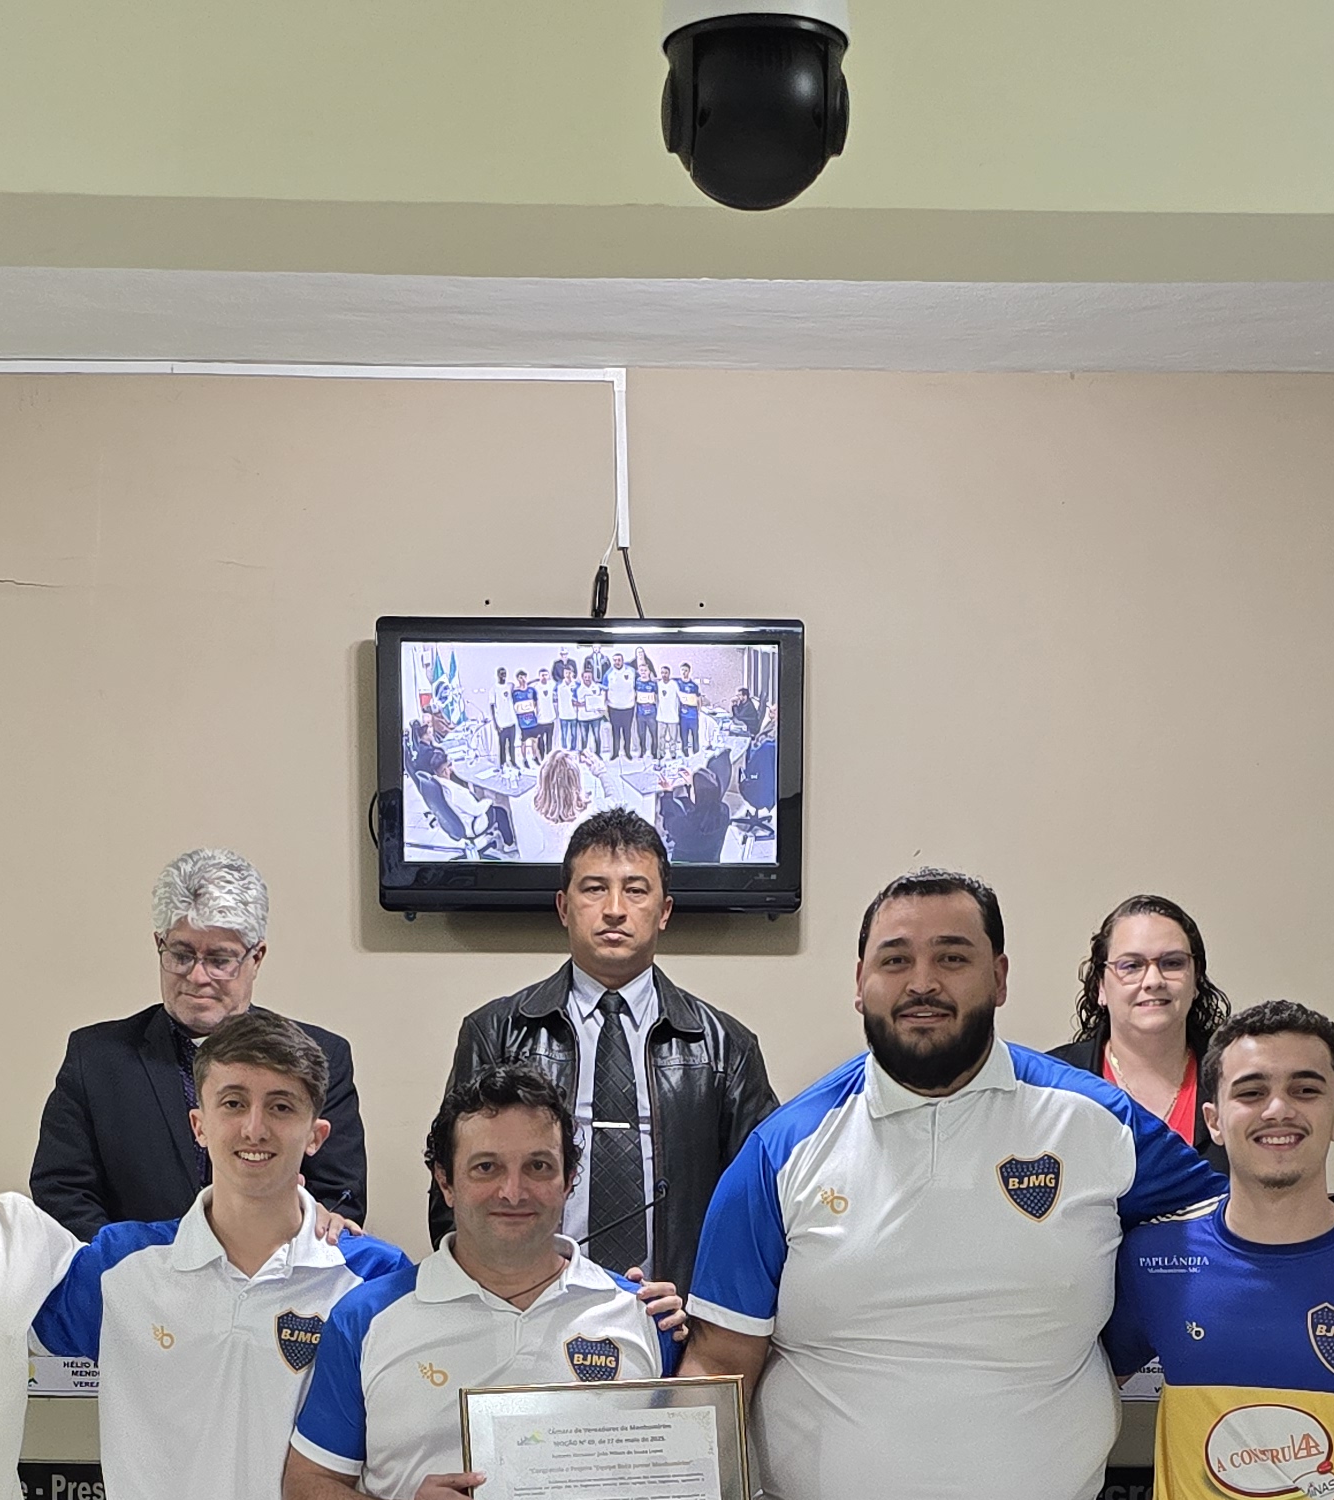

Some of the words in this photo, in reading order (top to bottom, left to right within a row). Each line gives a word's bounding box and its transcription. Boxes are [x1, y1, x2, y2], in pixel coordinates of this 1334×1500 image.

[1008, 1174, 1056, 1189] BJMG
[281, 1328, 322, 1344] BJMG
[573, 1353, 617, 1368] BJMG
[1217, 1456, 1227, 1472] A
